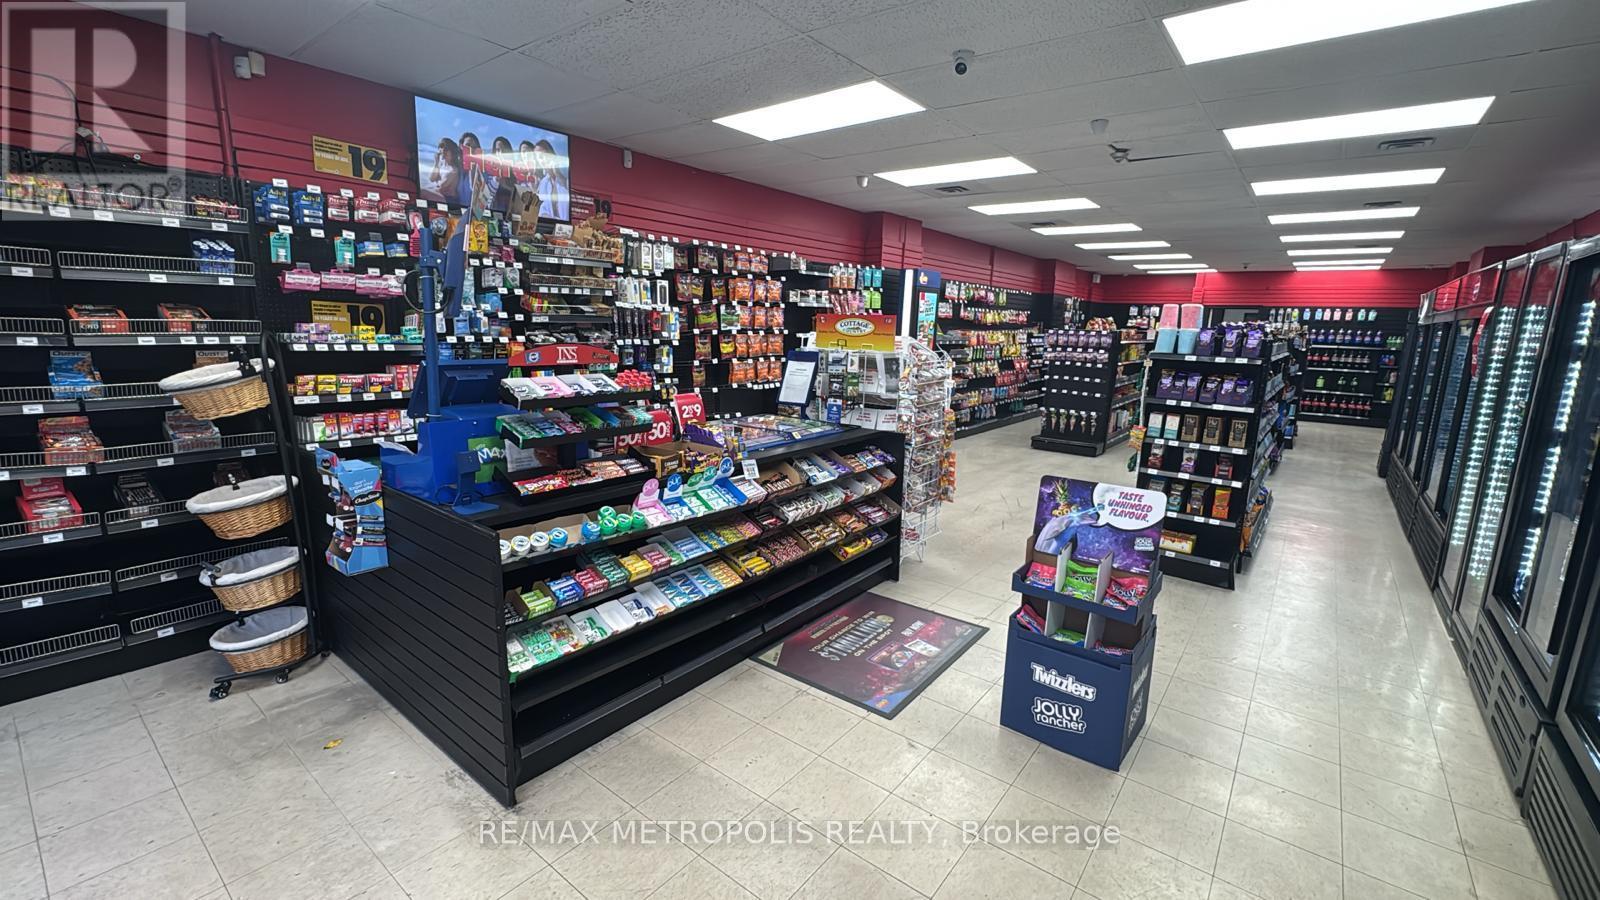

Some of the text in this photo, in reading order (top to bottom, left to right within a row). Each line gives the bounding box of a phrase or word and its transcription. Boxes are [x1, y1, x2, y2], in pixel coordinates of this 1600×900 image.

[348, 145, 385, 181] 19
[347, 305, 383, 334] 19
[839, 320, 869, 329] COTTAGE
[1107, 498, 1153, 513] UNHINGED
[1118, 491, 1145, 502] TASTE
[1108, 507, 1150, 523] FLAVOUR.
[809, 640, 830, 652] YOUR
[829, 623, 856, 640] CHANCE
[863, 641, 878, 649] THE
[877, 628, 893, 641] SPOT
[1031, 662, 1096, 701] Twizzlers
[1033, 698, 1082, 720] JOLLY
[1034, 712, 1086, 733] rancher
